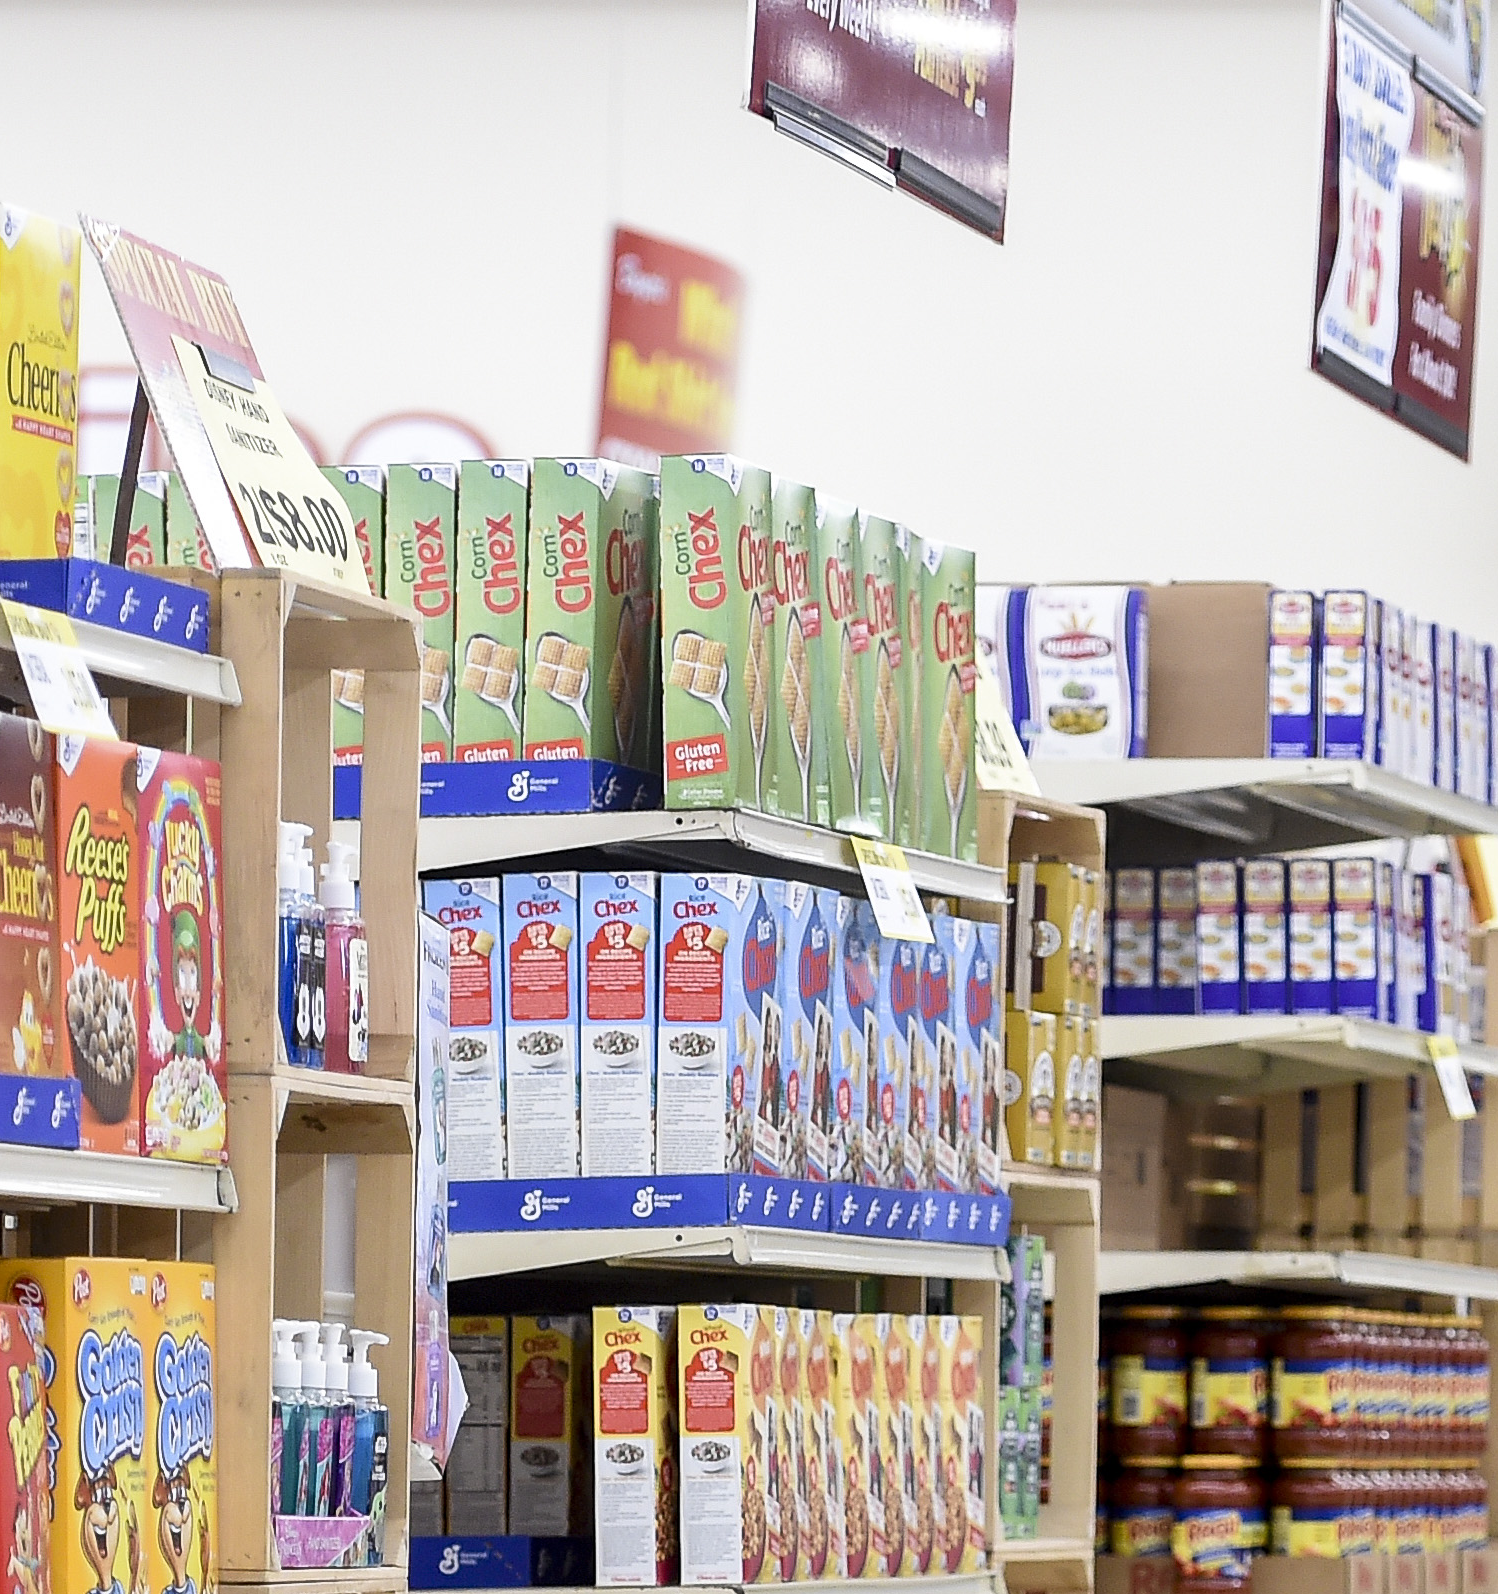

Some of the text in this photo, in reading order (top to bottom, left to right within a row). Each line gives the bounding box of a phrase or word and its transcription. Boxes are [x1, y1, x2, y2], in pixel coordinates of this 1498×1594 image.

[400, 538, 418, 584] Corn
[413, 515, 451, 618] Chex
[471, 535, 486, 581] Corn
[483, 512, 522, 615] Chex
[543, 532, 557, 578] Corn
[554, 510, 593, 614] Chex
[675, 530, 689, 576] Corn
[689, 505, 728, 611] Chex
[464, 746, 510, 762] Gluten
[533, 744, 579, 760] Gluten
[674, 740, 721, 762] Gluten
[685, 757, 715, 772] Free
[65, 805, 130, 884] Reese's
[74, 876, 126, 954] Puffs
[438, 906, 483, 925] Chex
[517, 900, 562, 919] Chex
[594, 898, 639, 918] Chex
[673, 900, 718, 919] Chex
[604, 1330, 644, 1346] Chex
[690, 1328, 729, 1345] Chex
